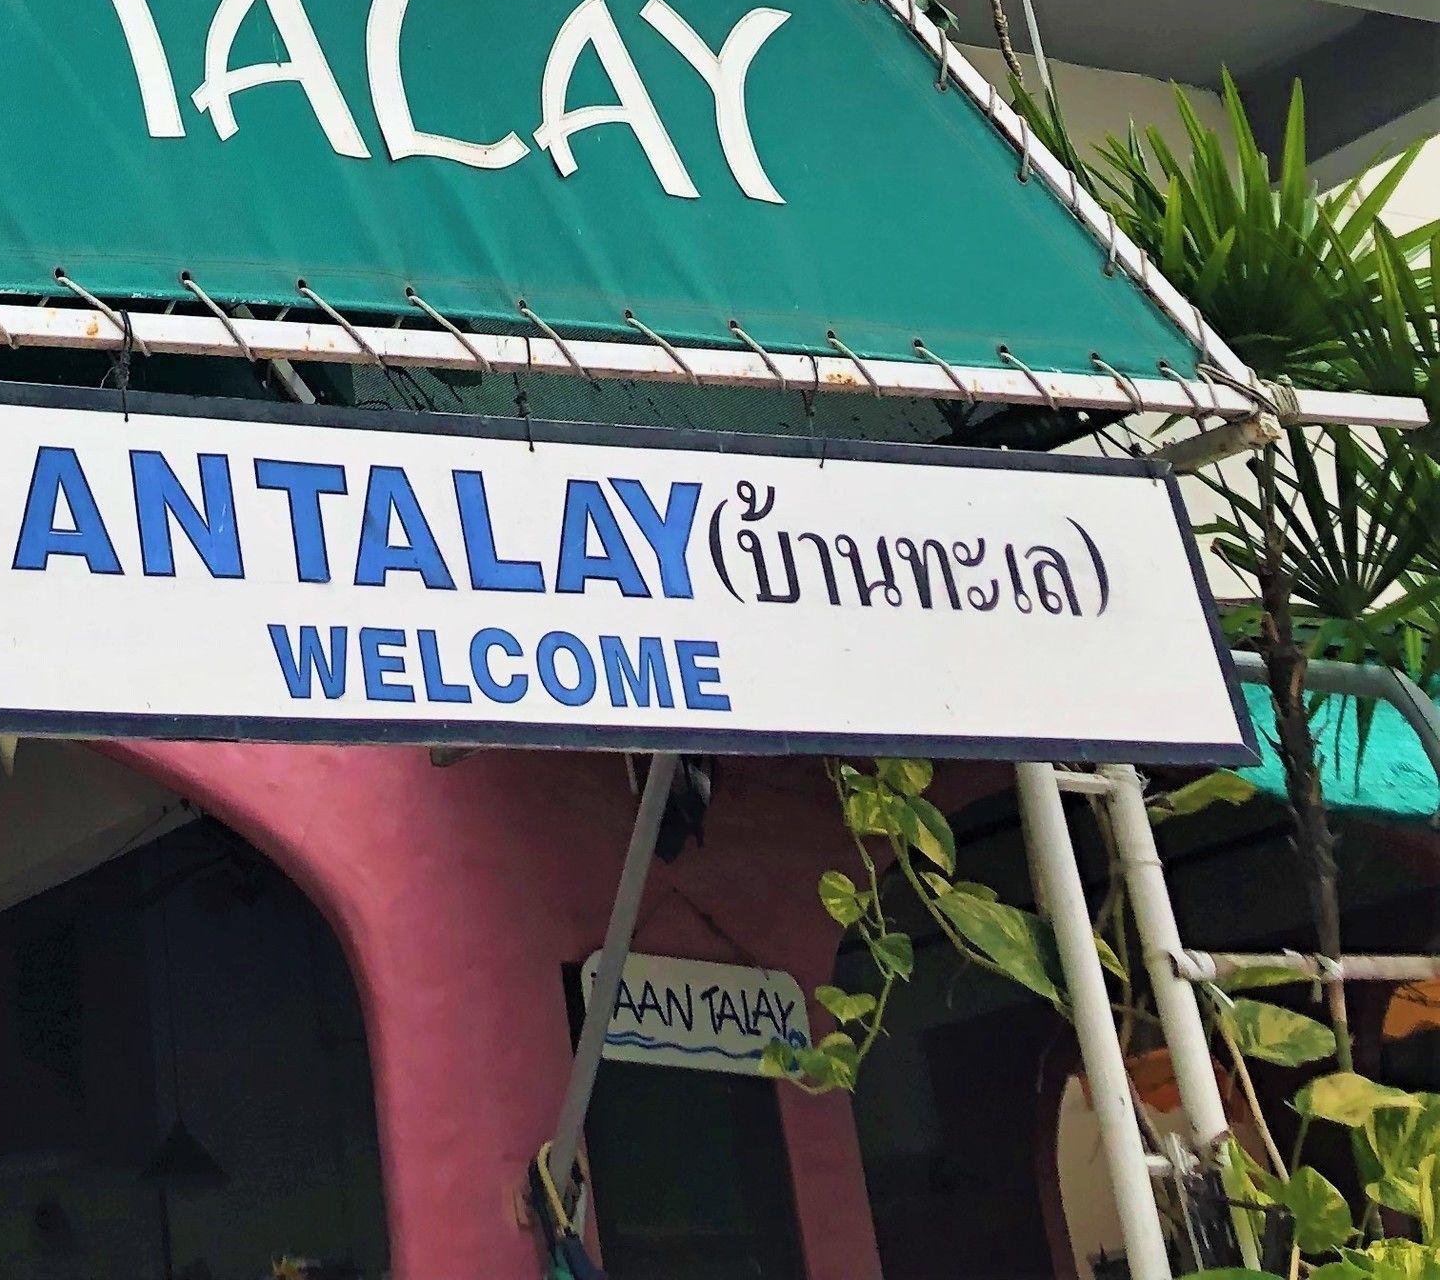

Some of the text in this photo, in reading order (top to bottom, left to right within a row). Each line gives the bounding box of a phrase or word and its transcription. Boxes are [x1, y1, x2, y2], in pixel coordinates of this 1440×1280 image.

[267, 623, 732, 712] WELCOME
[612, 978, 796, 1039] AAN TALAY
